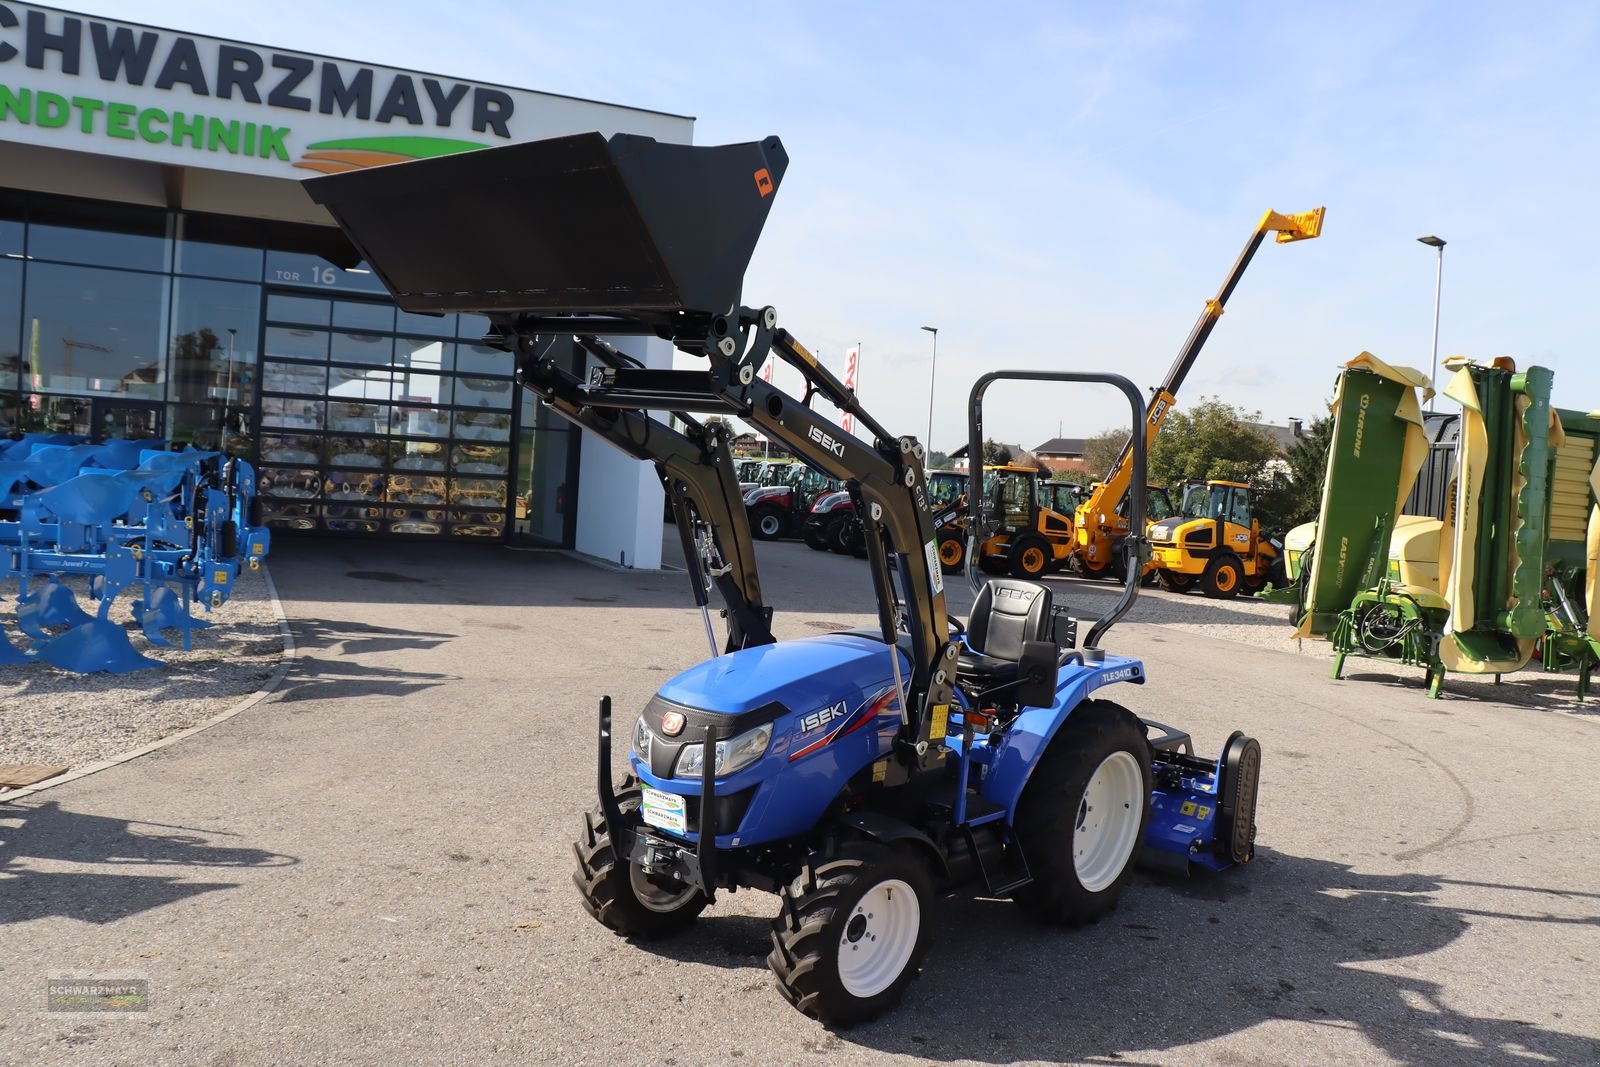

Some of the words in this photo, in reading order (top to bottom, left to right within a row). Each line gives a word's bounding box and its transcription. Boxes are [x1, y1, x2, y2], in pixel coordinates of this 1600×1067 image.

[0, 84, 291, 161] NDTECHNIK
[275, 270, 300, 281] TOR
[312, 266, 336, 285] 16
[1151, 399, 1167, 425] JCB
[808, 424, 845, 458] ISEKI
[1353, 408, 1366, 459] KRONE
[995, 586, 1035, 601] ISEKI
[800, 700, 847, 733] ISEKI
